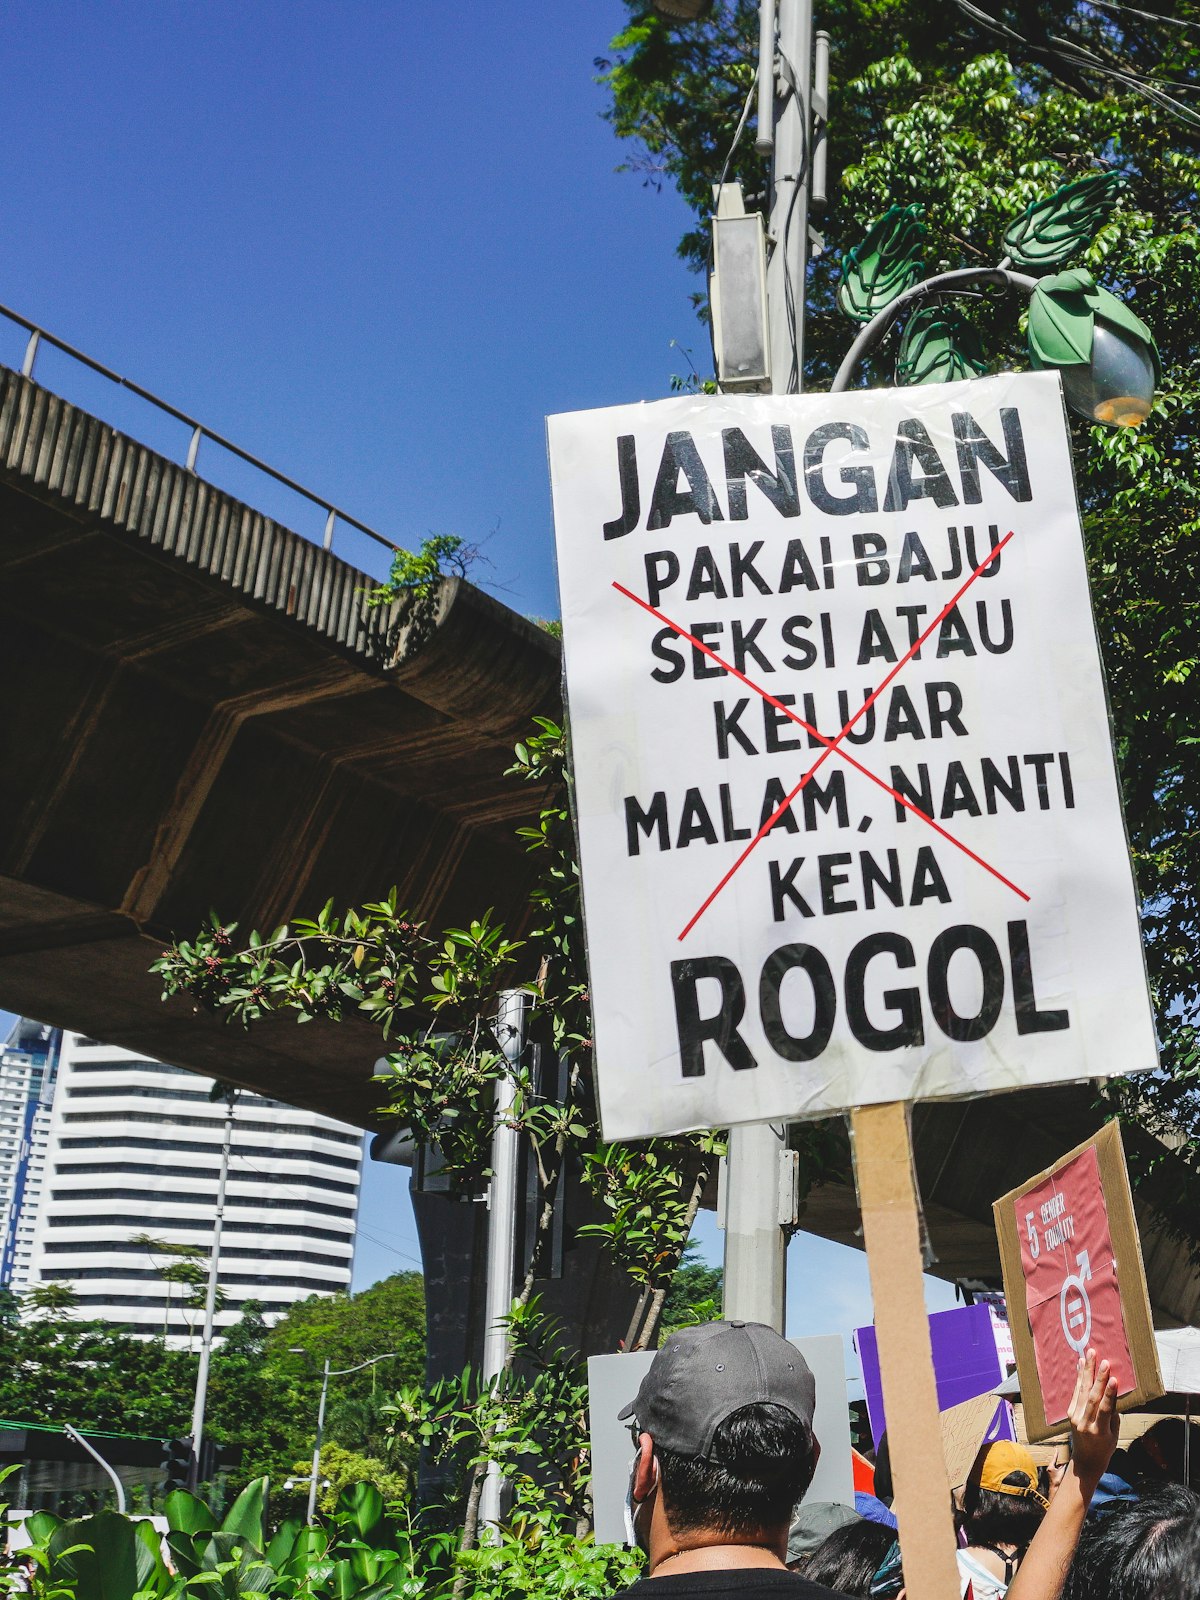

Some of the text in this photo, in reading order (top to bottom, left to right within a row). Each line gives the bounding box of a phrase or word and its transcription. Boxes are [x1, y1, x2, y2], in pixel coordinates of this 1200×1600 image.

[603, 407, 1033, 541] JANGAN
[644, 524, 1003, 608] PAKAI BAJU
[650, 598, 1014, 684] SEKSI ATAU
[714, 681, 969, 759] KELUAR
[623, 752, 1075, 856] MALAM, NANTI
[768, 846, 952, 922] KENA
[670, 919, 1070, 1078] ROGOL
[1025, 1210, 1040, 1259] 5
[1040, 1192, 1066, 1225] GENDER
[1044, 1214, 1075, 1252] EQUALITY
